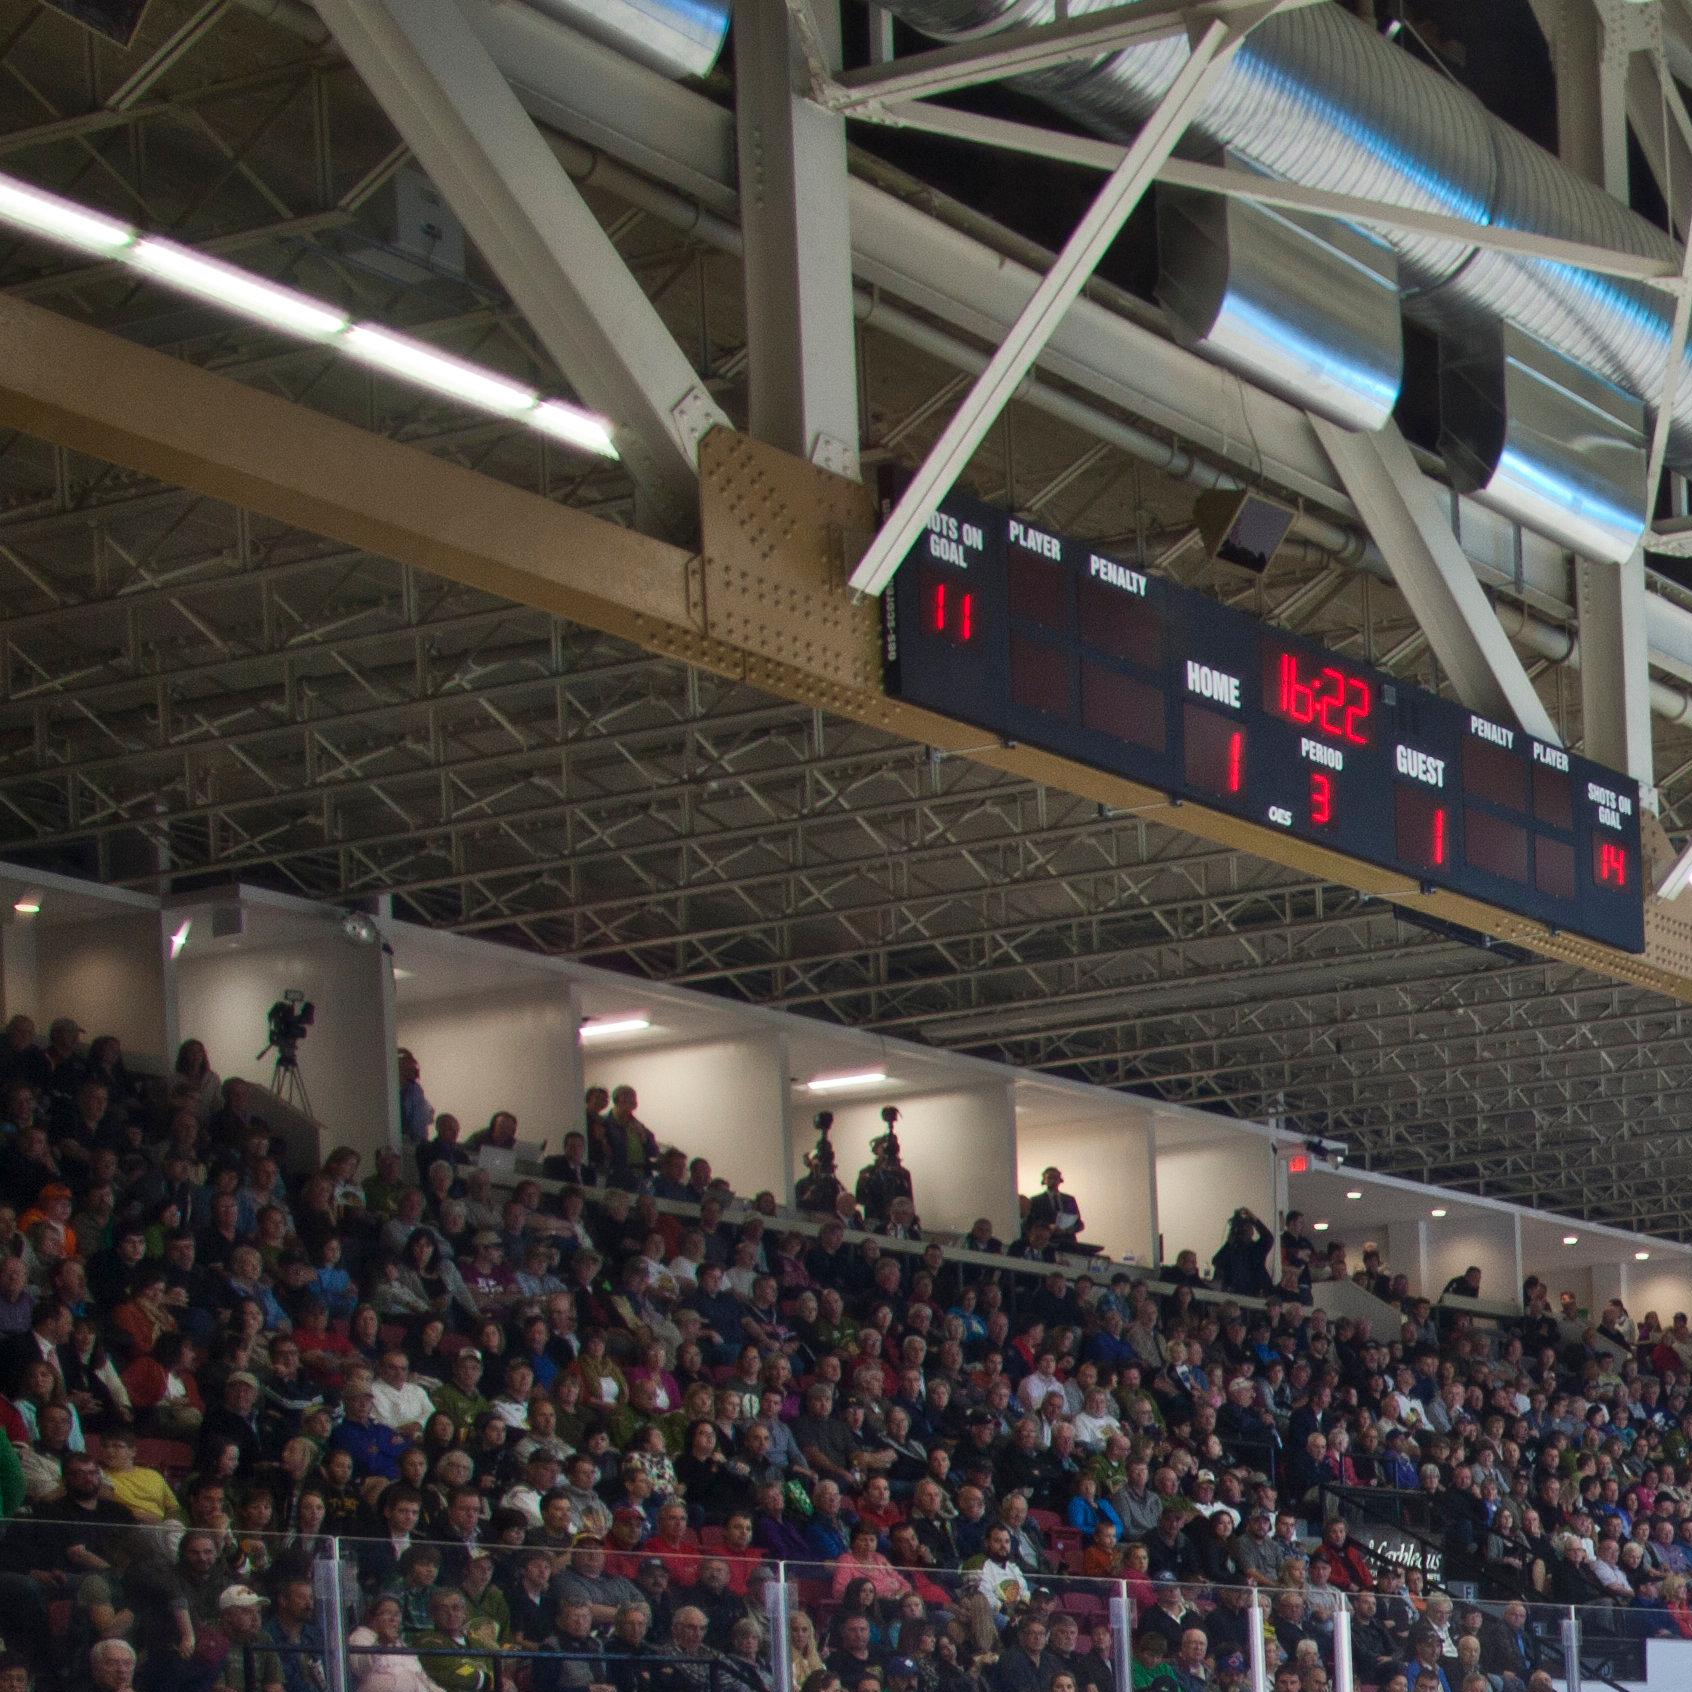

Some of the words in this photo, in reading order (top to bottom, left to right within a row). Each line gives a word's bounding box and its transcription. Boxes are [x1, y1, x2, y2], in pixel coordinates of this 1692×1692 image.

[929, 533, 968, 569] GOAL
[963, 523, 984, 551] ON
[1009, 520, 1062, 563] PLAYER
[1090, 553, 1148, 598] PENALTY
[936, 583, 972, 641] 11
[1187, 660, 1241, 709] HOME
[1280, 654, 1371, 745] 16:22
[1470, 714, 1514, 749] PENALTY
[1229, 732, 1242, 792] 1
[1301, 736, 1344, 772] PERIOD
[1396, 744, 1445, 788] GUEST
[1533, 741, 1569, 772] PLAYER
[1268, 805, 1293, 826] OES
[1311, 773, 1330, 824] 3
[1588, 782, 1617, 809] SHOTS
[1618, 795, 1632, 816] ON
[1598, 806, 1622, 831] GOAL
[1434, 808, 1445, 865] 1
[1600, 842, 1626, 887] 14
